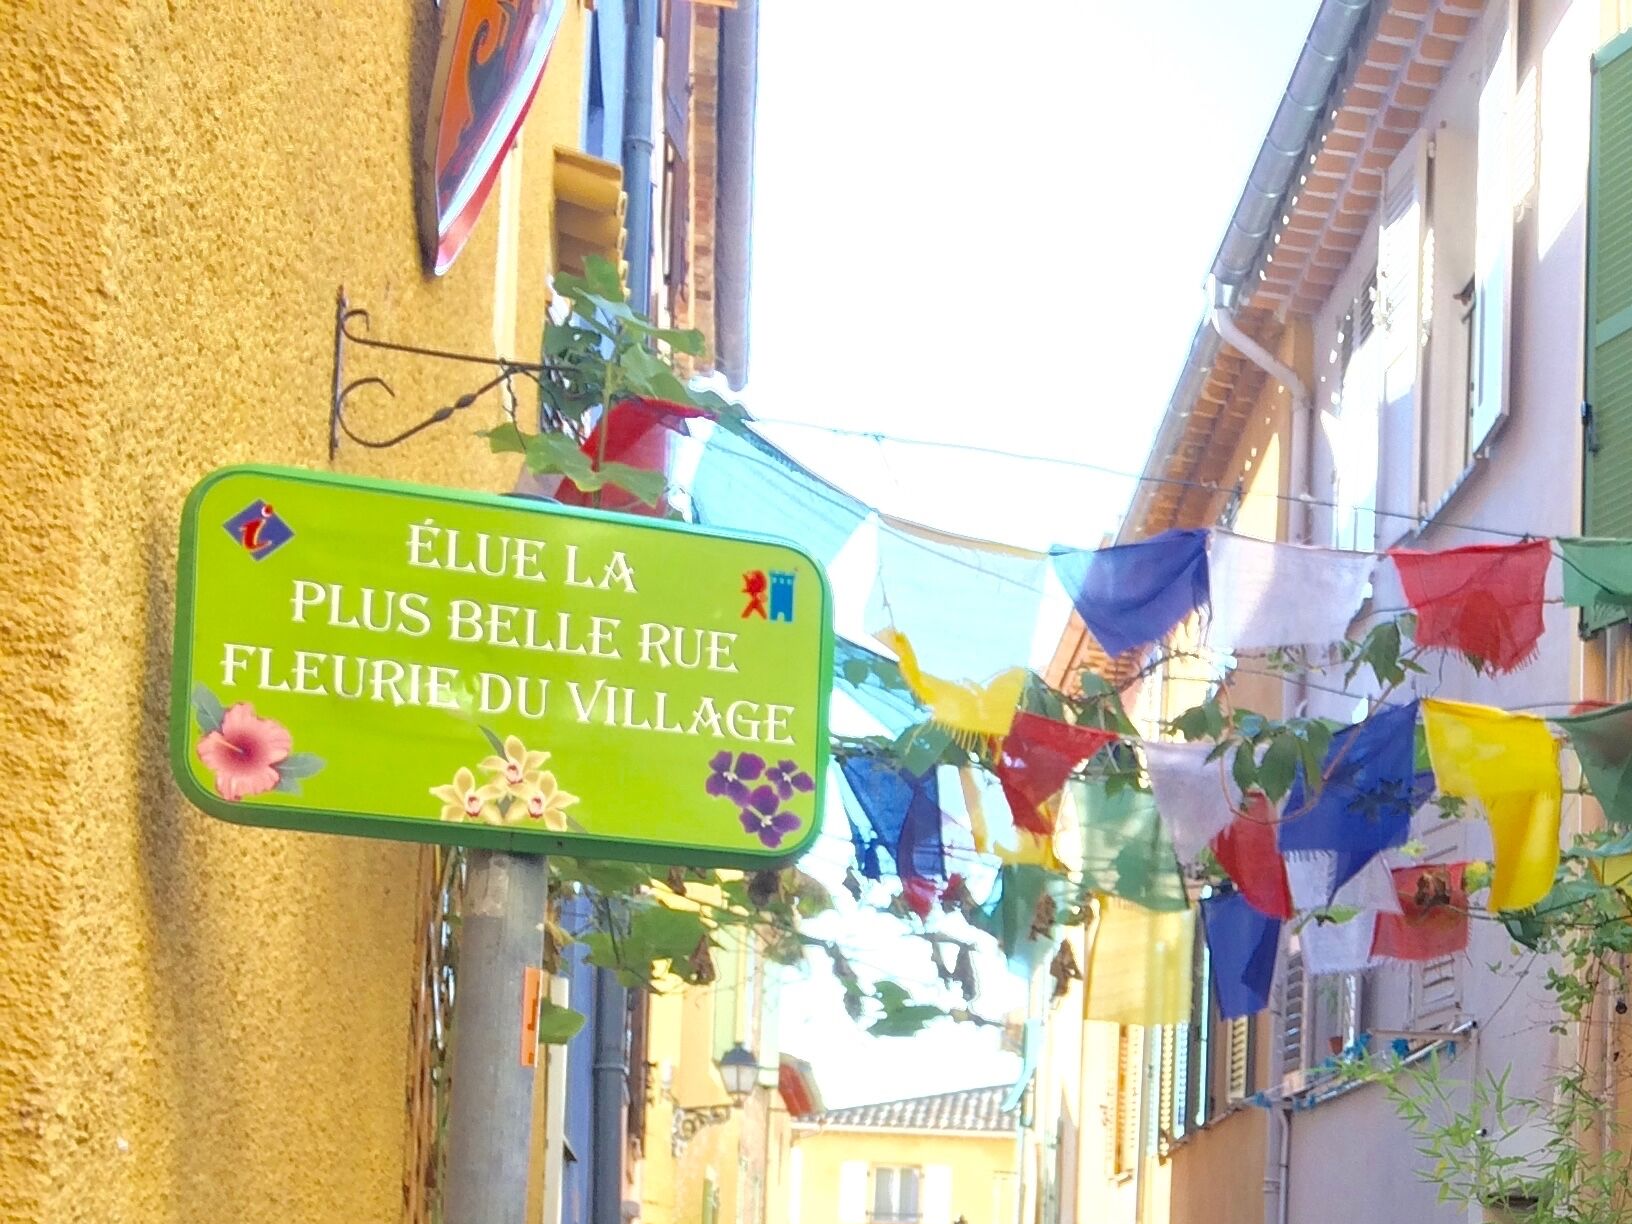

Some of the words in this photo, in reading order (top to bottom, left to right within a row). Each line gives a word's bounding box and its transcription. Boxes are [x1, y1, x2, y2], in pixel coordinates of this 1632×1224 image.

[406, 518, 546, 582] ÉLUE
[564, 544, 638, 594] LA
[290, 580, 431, 636] PLUS
[448, 598, 621, 660] BELLE
[638, 622, 740, 674] RUE
[221, 643, 460, 711] FLEURIE
[479, 673, 549, 720] DU
[566, 680, 796, 746] VILLAGE
